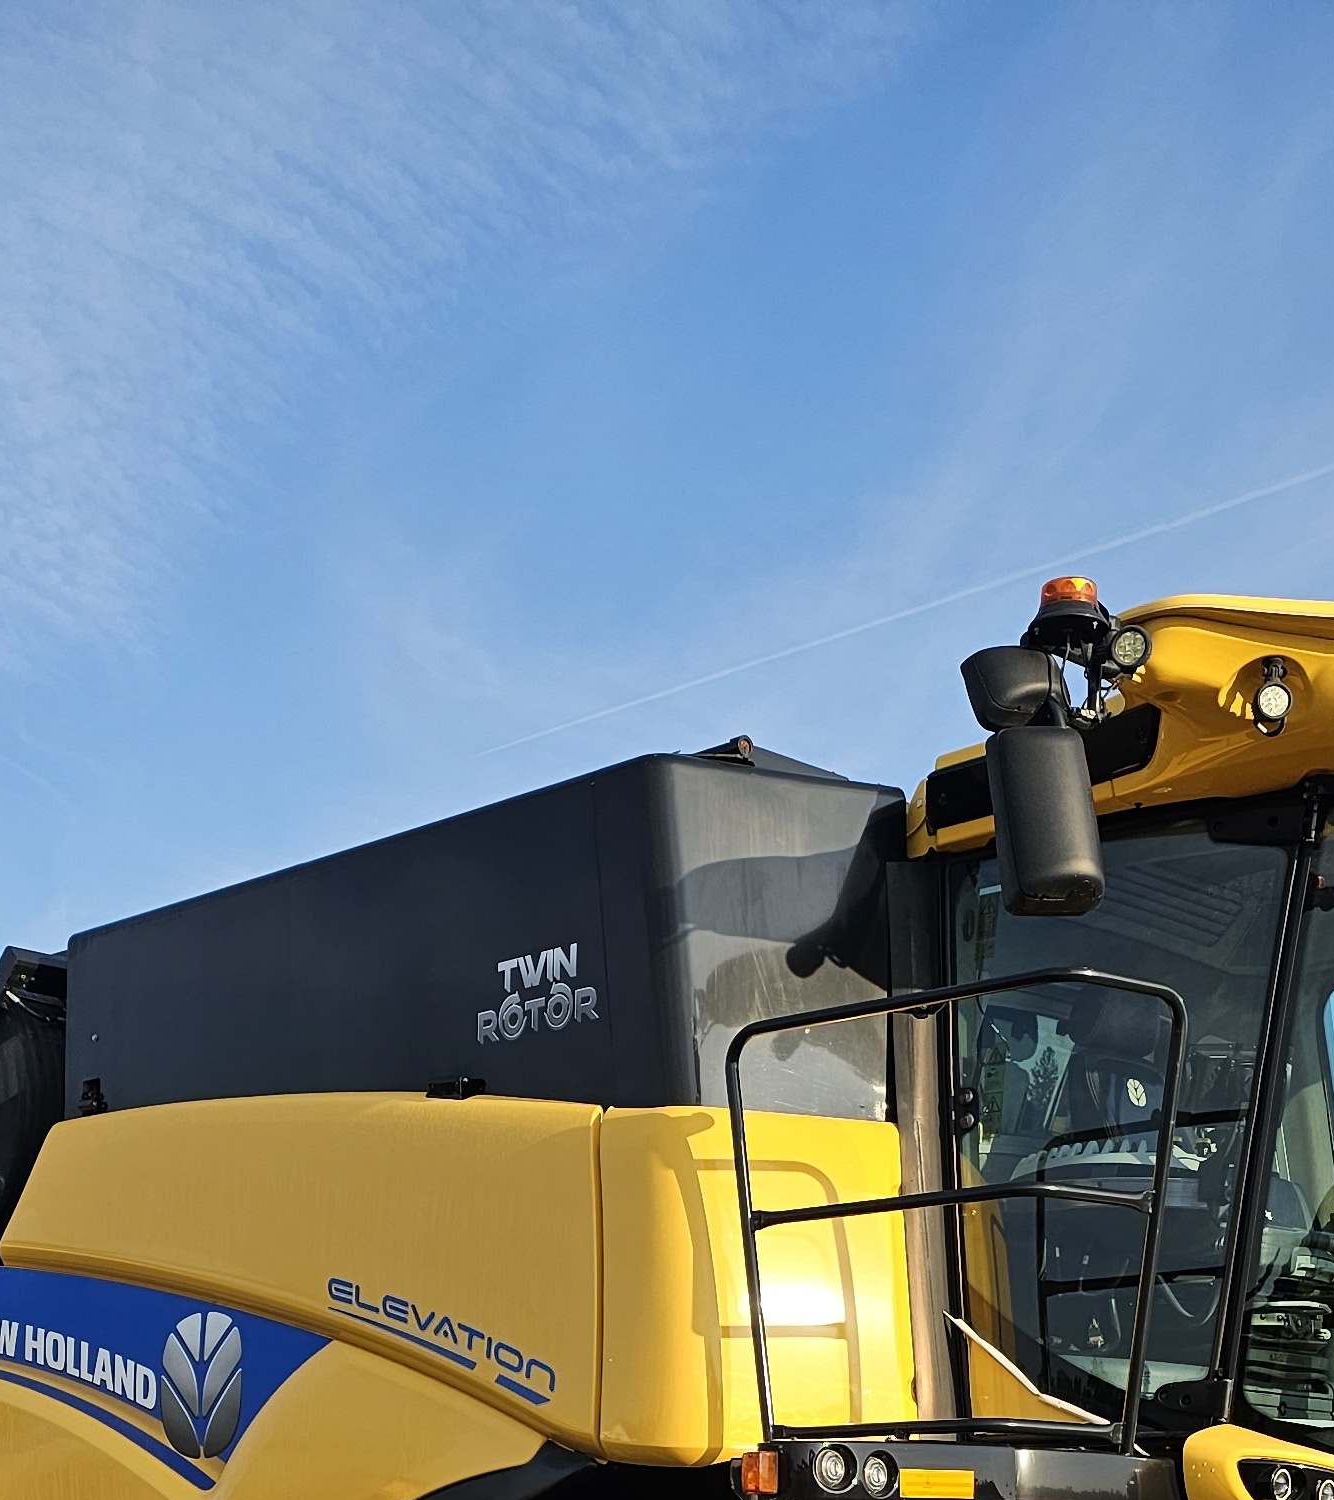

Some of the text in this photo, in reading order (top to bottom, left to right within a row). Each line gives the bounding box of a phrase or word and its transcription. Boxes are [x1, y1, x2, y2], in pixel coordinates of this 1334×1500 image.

[497, 943, 577, 993] TWIN
[477, 982, 599, 1045] ROTOR
[24, 1325, 157, 1410] HOLLAND
[327, 1277, 556, 1392] ELEVATION
